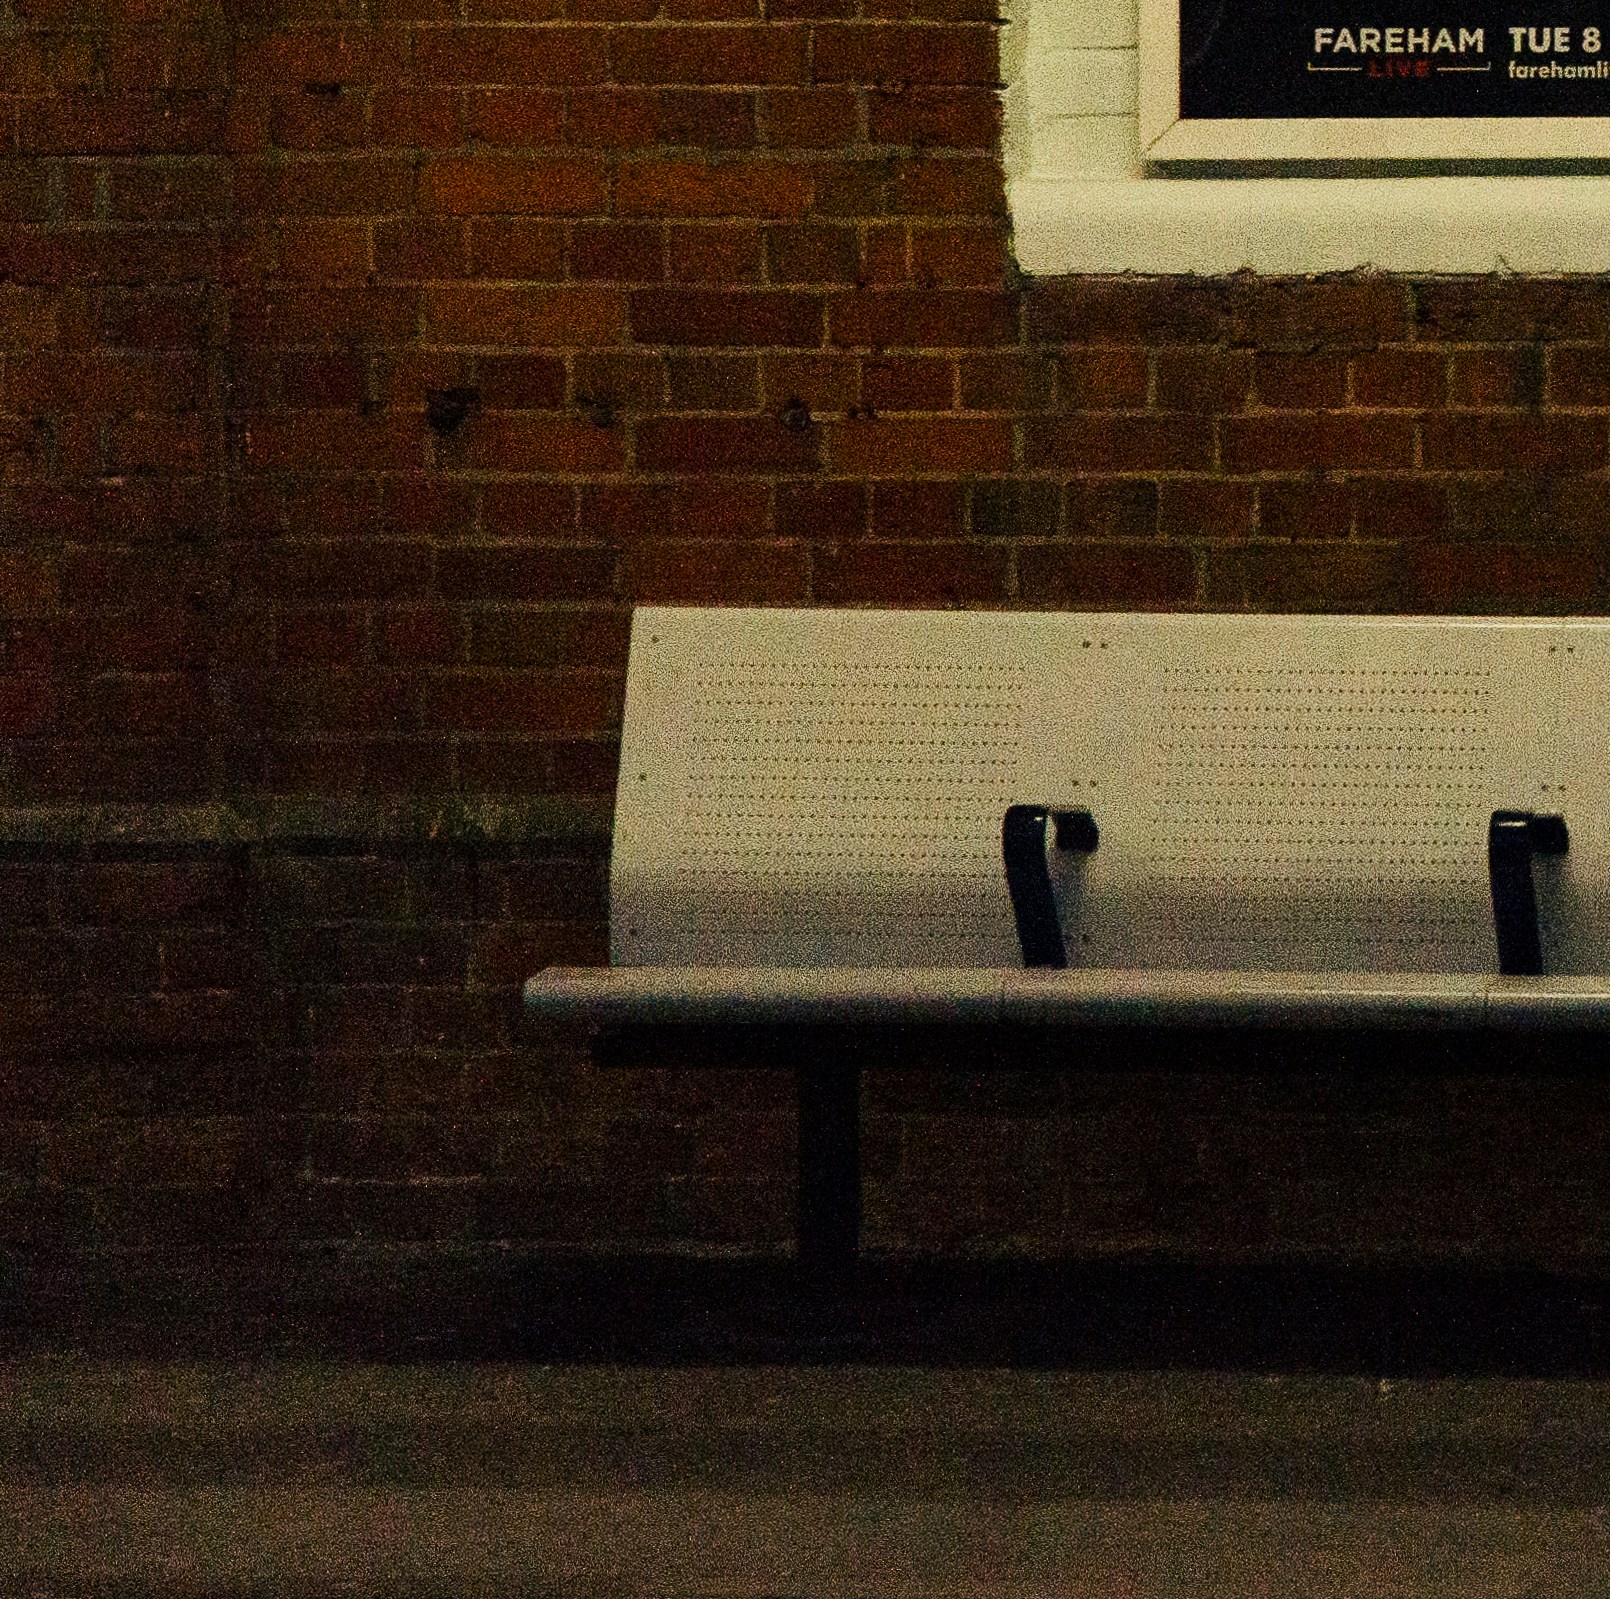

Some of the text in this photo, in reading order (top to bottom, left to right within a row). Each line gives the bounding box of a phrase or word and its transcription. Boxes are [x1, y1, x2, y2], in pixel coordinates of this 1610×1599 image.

[1315, 28, 1484, 53] FAREHAM
[1509, 27, 1569, 53] TUE
[1582, 27, 1601, 52] 8
[1368, 60, 1434, 78] LIVE
